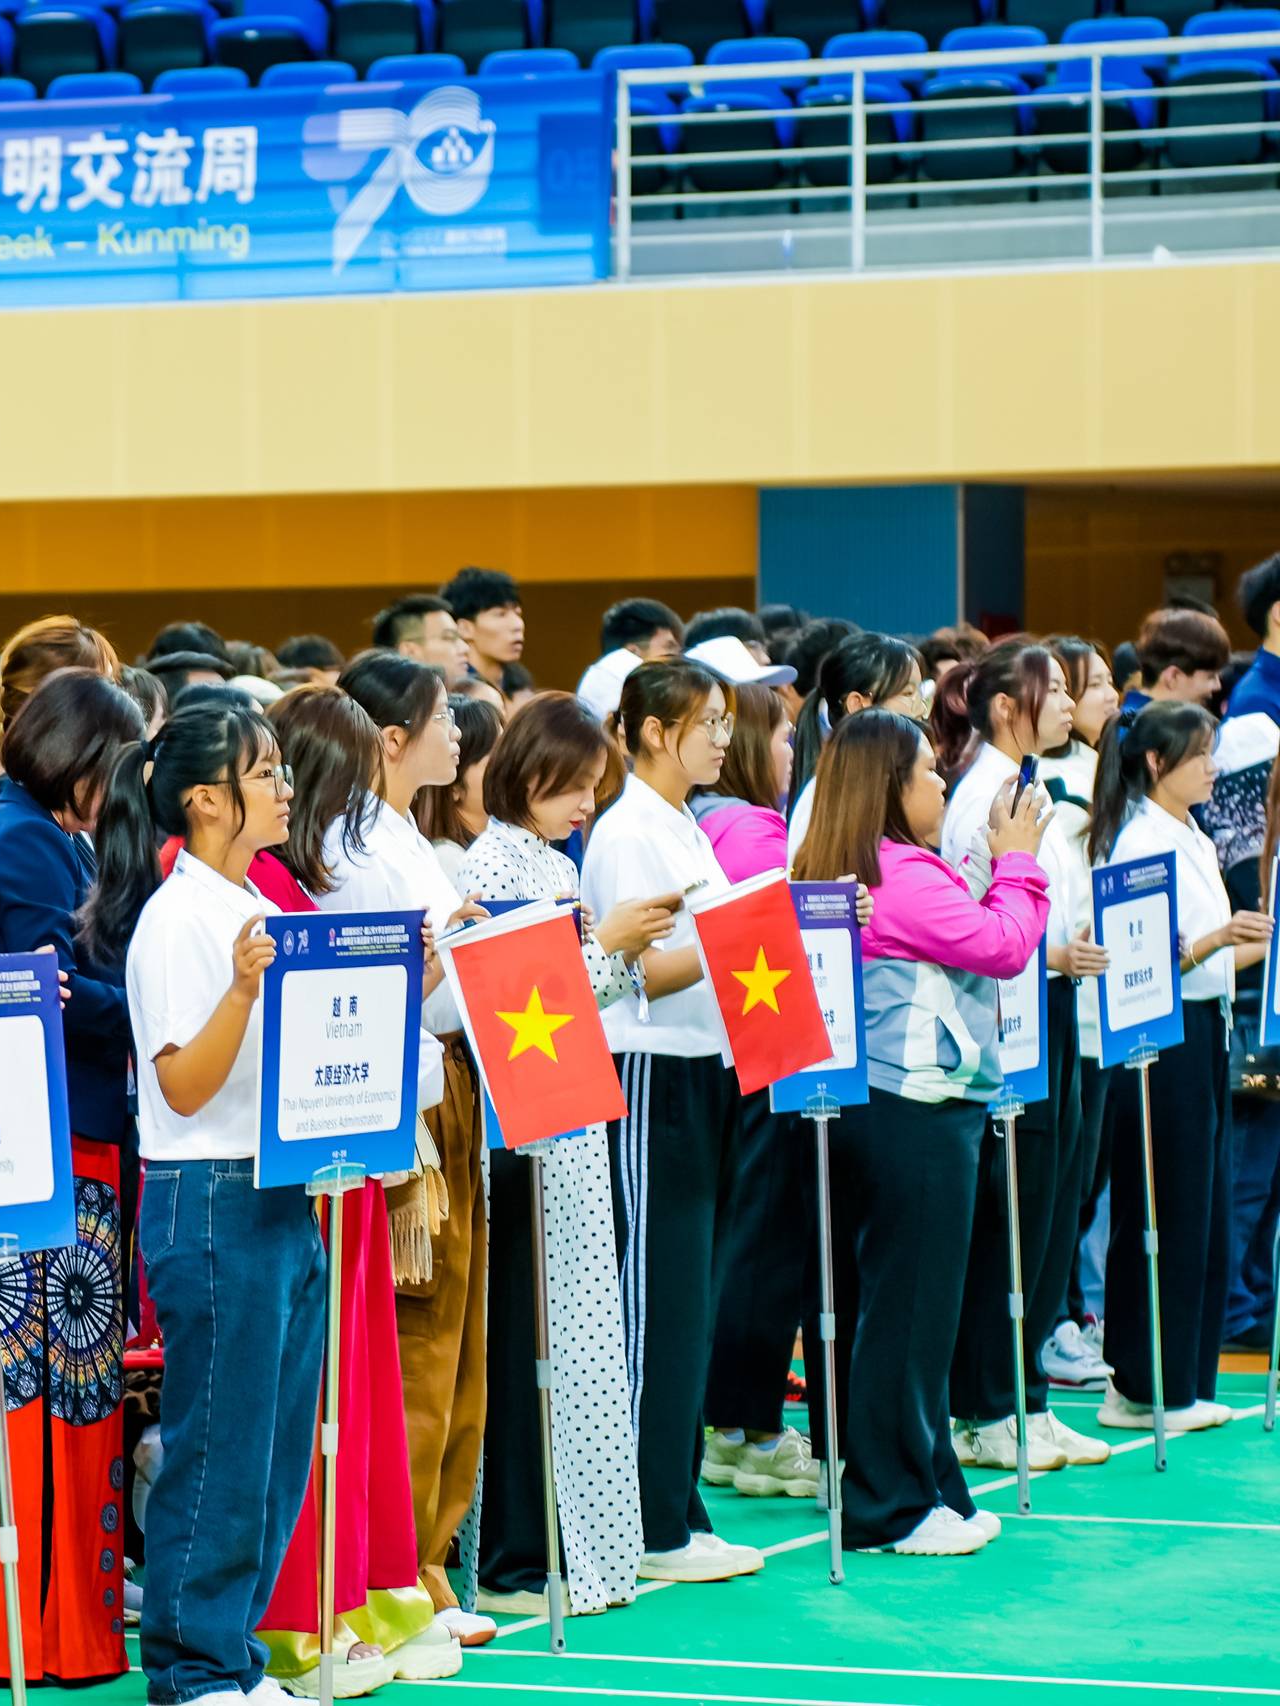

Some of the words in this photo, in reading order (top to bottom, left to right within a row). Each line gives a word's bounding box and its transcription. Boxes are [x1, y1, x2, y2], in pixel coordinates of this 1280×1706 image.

[96, 219, 250, 261] Kunming
[325, 1019, 363, 1040] Vietnam
[325, 1094, 355, 1110] University
[364, 1088, 397, 1104] Economics
[310, 1116, 338, 1132] Business
[339, 1111, 384, 1129] Administration
